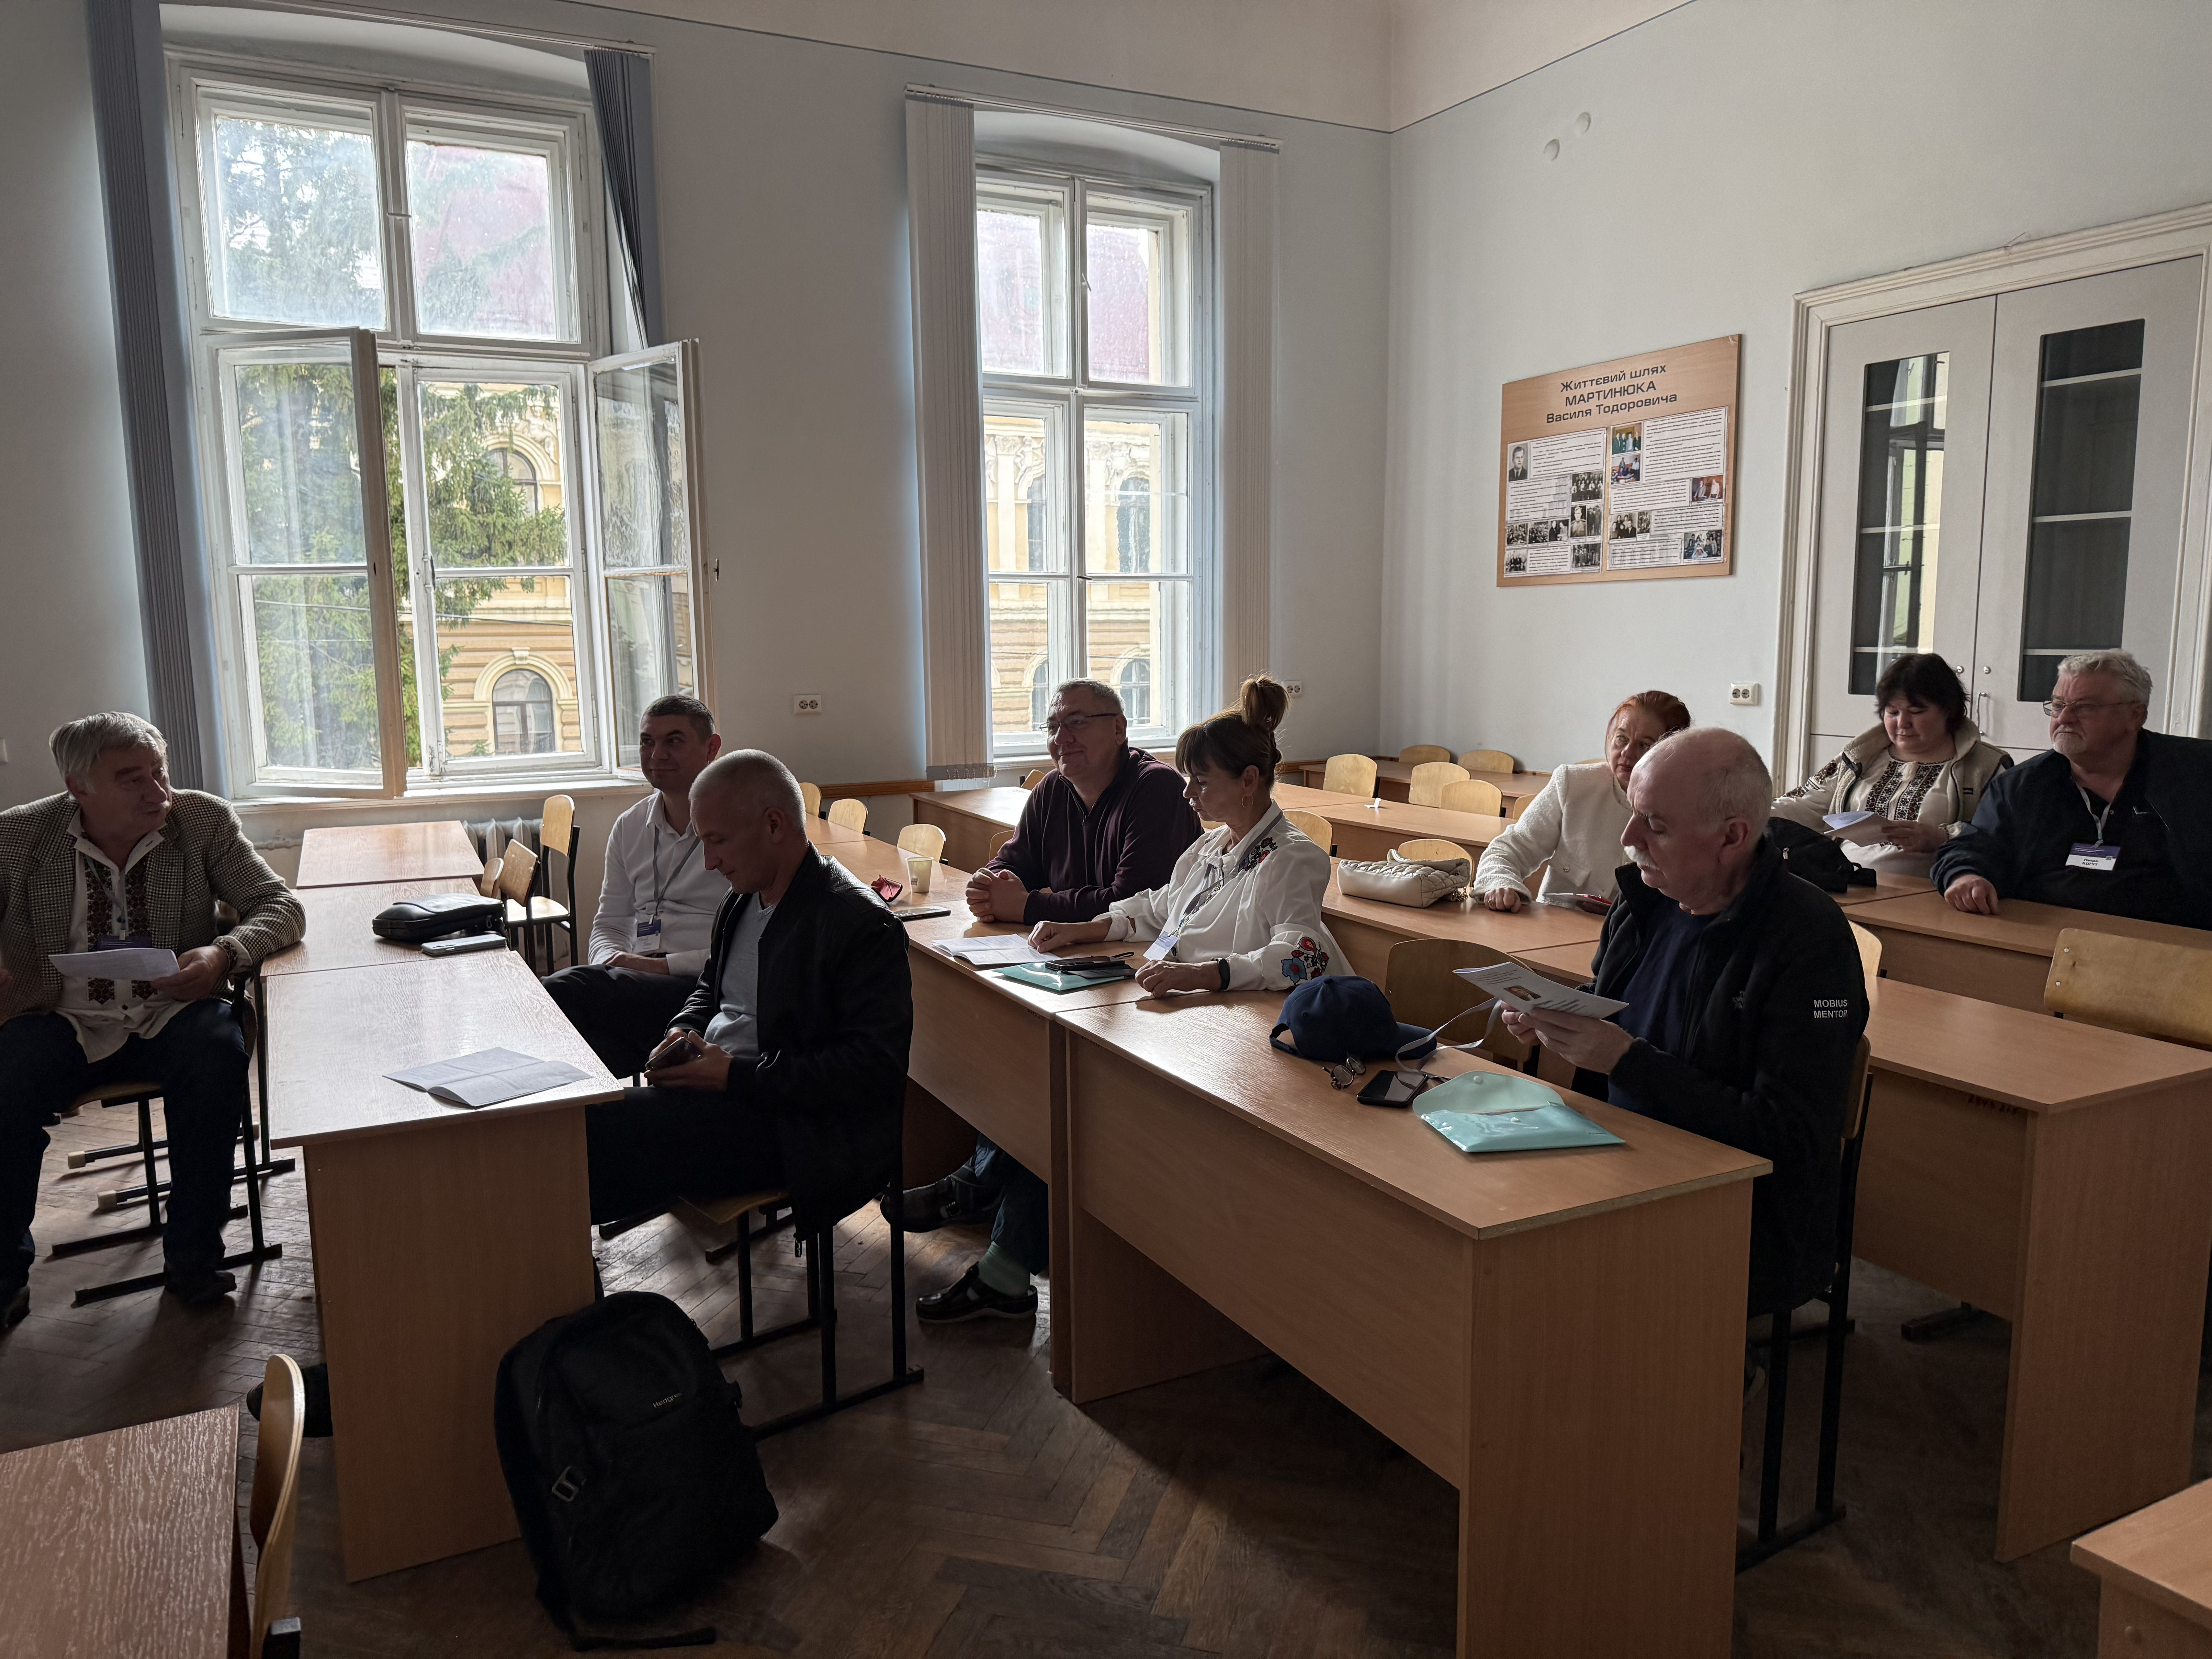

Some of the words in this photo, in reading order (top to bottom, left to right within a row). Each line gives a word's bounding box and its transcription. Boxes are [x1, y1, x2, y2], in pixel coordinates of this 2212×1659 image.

[1560, 370, 1626, 393] Життєвий
[1630, 364, 1667, 379] шлях
[1565, 381, 1657, 407] МАРТИНЮКА
[1546, 409, 1592, 424] Василя
[1595, 394, 1678, 414] Тодоровича
[1814, 999, 1848, 1008] MOBIUS
[1814, 1010, 1848, 1018] MENTOR
